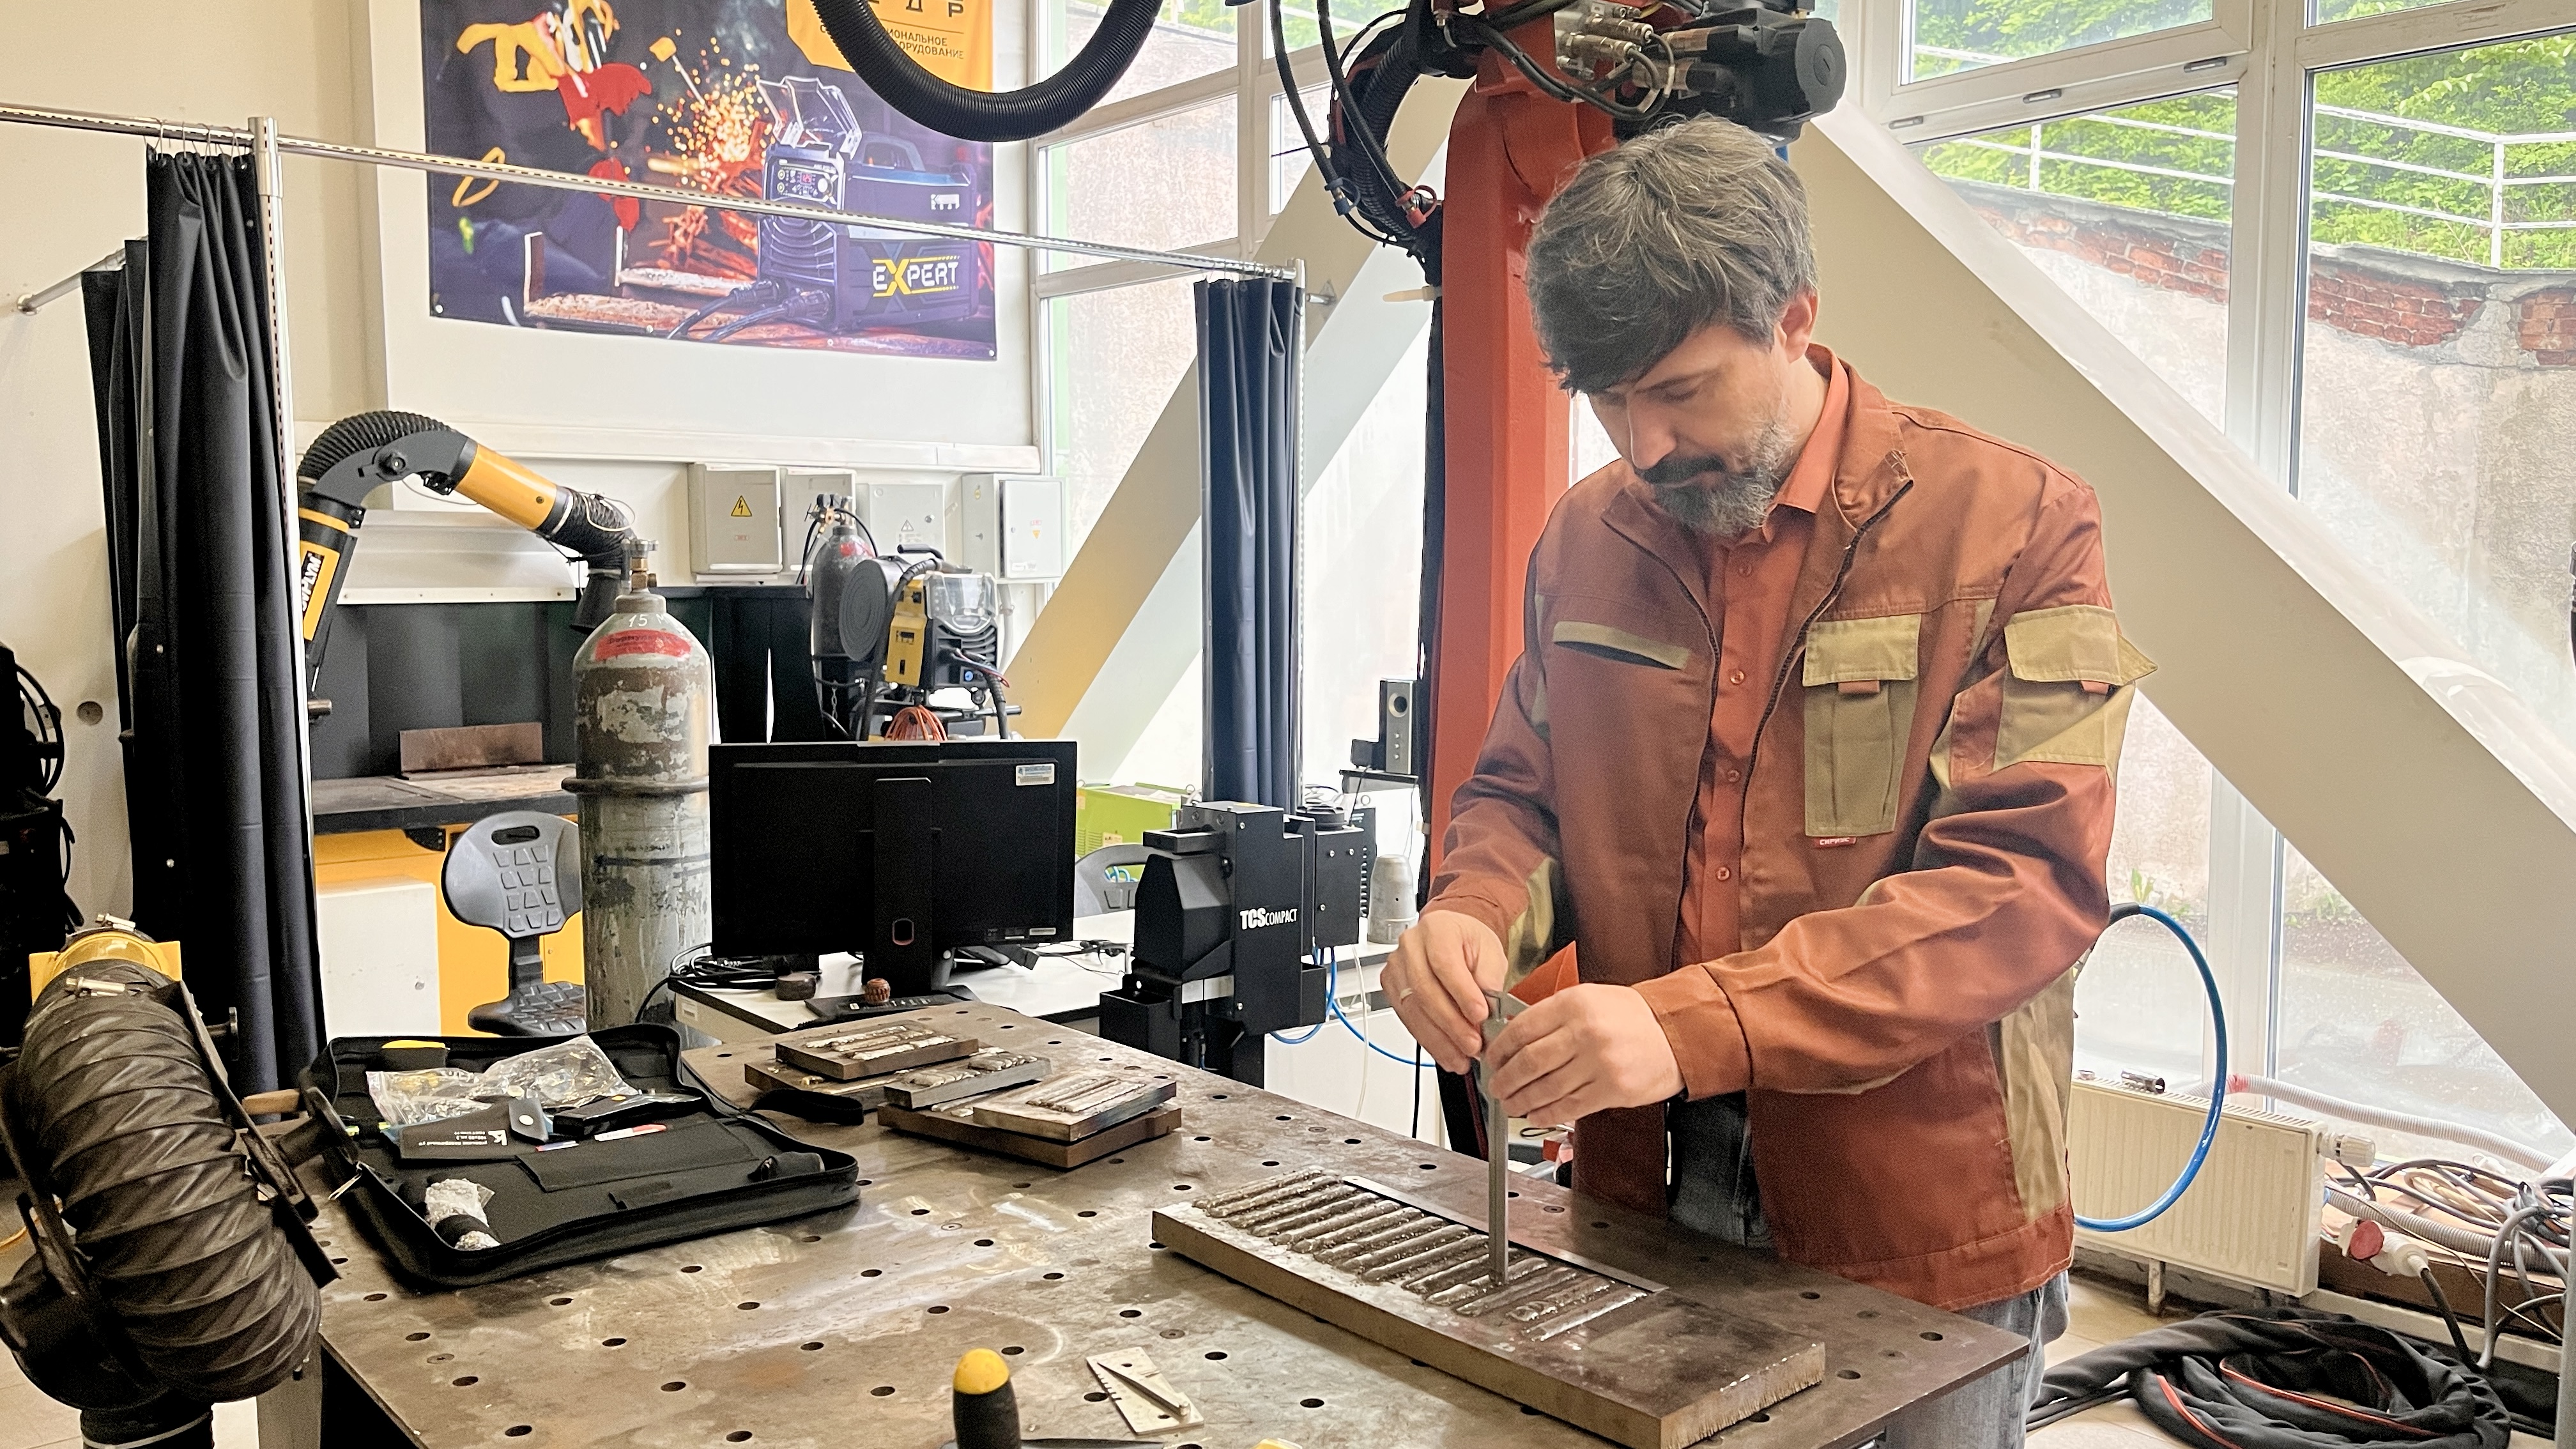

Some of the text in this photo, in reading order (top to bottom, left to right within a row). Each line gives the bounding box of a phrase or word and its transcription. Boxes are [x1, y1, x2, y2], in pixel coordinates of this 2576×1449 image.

[895, 40, 964, 59] ОРУДОВАНИЕ
[873, 258, 959, 296] EXPERT
[629, 614, 648, 627] 15
